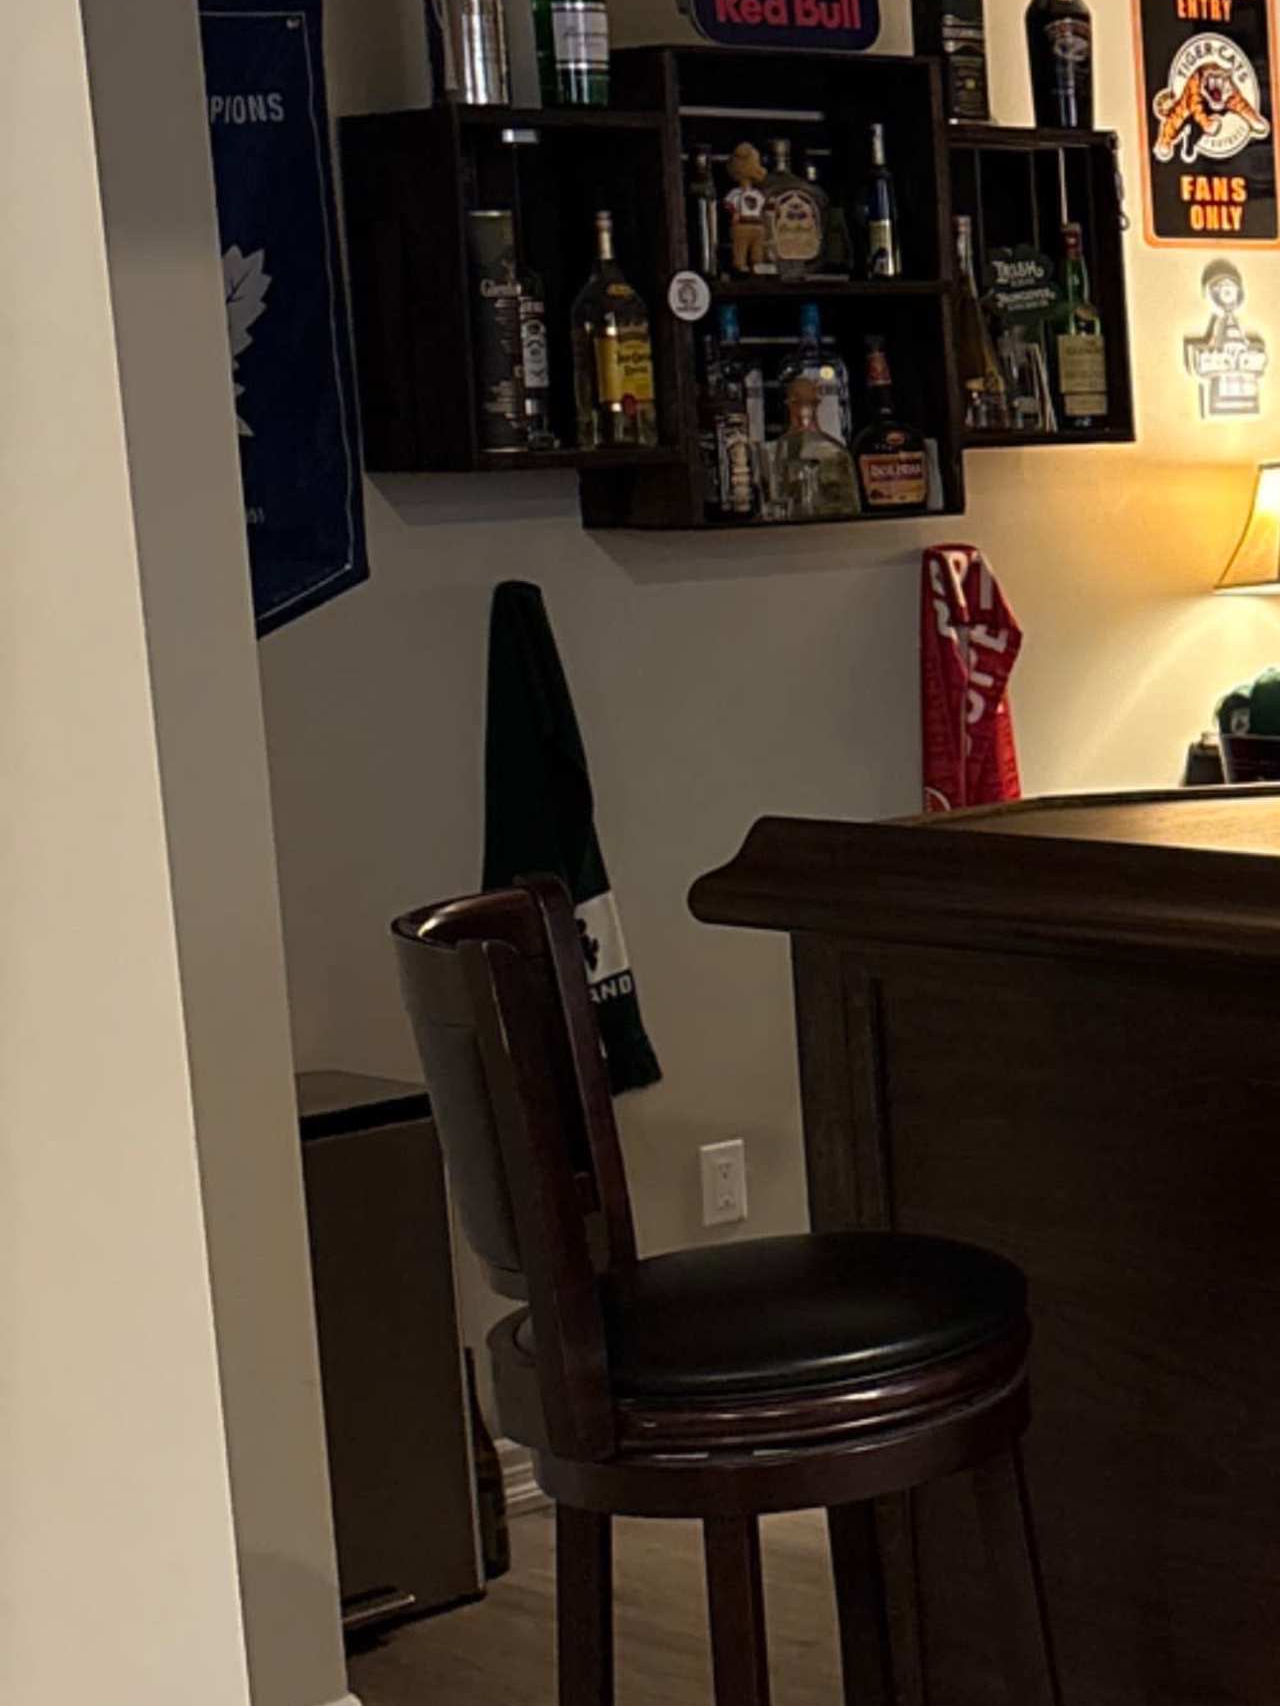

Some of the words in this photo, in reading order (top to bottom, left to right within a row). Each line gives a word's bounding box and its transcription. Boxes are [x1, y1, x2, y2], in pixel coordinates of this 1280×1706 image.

[209, 93, 285, 122] PIONS
[1181, 176, 1247, 203] FANS
[1191, 205, 1243, 231] ONLY
